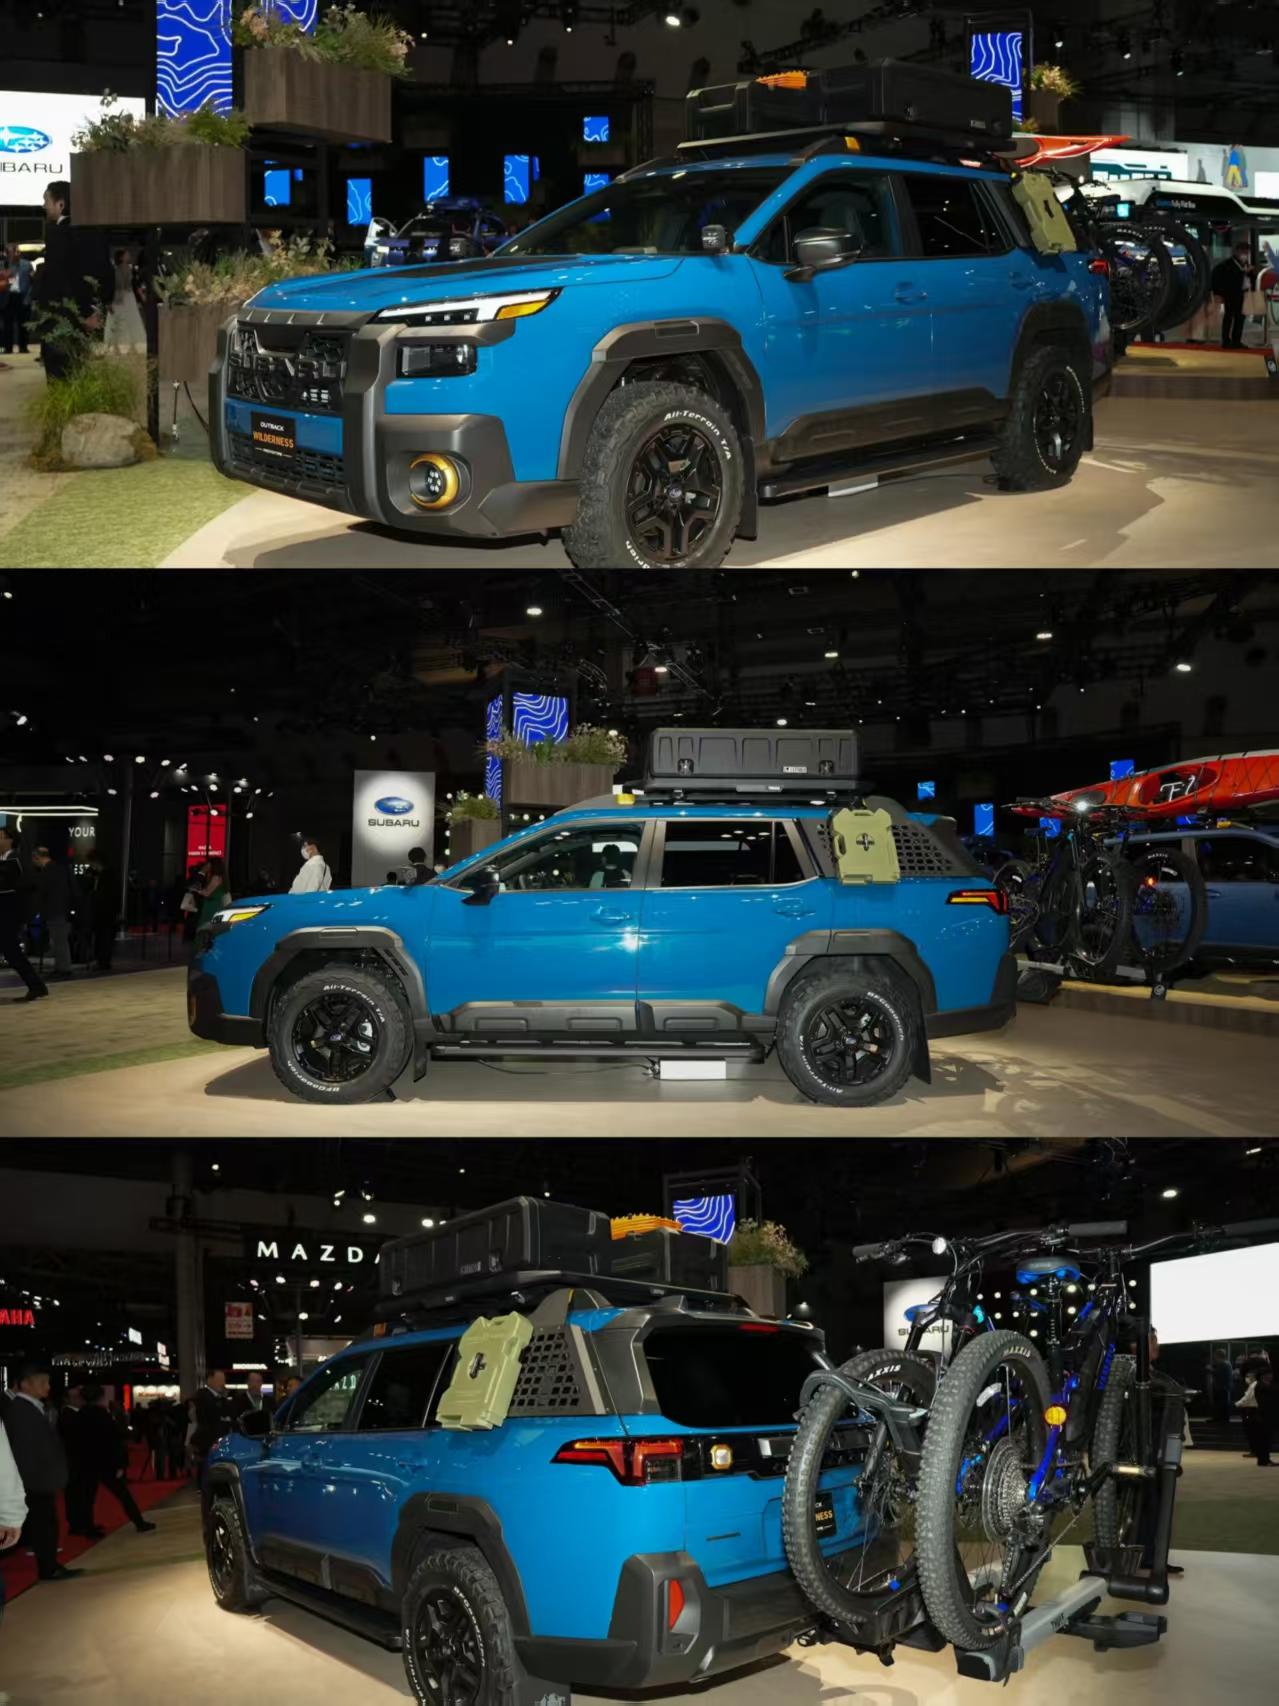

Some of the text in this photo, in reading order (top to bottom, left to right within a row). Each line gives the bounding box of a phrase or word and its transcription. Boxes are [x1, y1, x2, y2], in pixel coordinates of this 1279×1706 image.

[0, 161, 63, 174] BARU
[260, 421, 285, 431] OUTBACK
[664, 410, 730, 436] All-Terrain
[253, 431, 294, 449] WILDERNESS
[367, 818, 420, 828] SUBARU
[68, 826, 96, 837] YOUR
[257, 1240, 380, 1264] MAZD
[0, 1309, 35, 1326] AHA
[898, 1325, 950, 1337] SUARU
[864, 1364, 902, 1382] AXXIS
